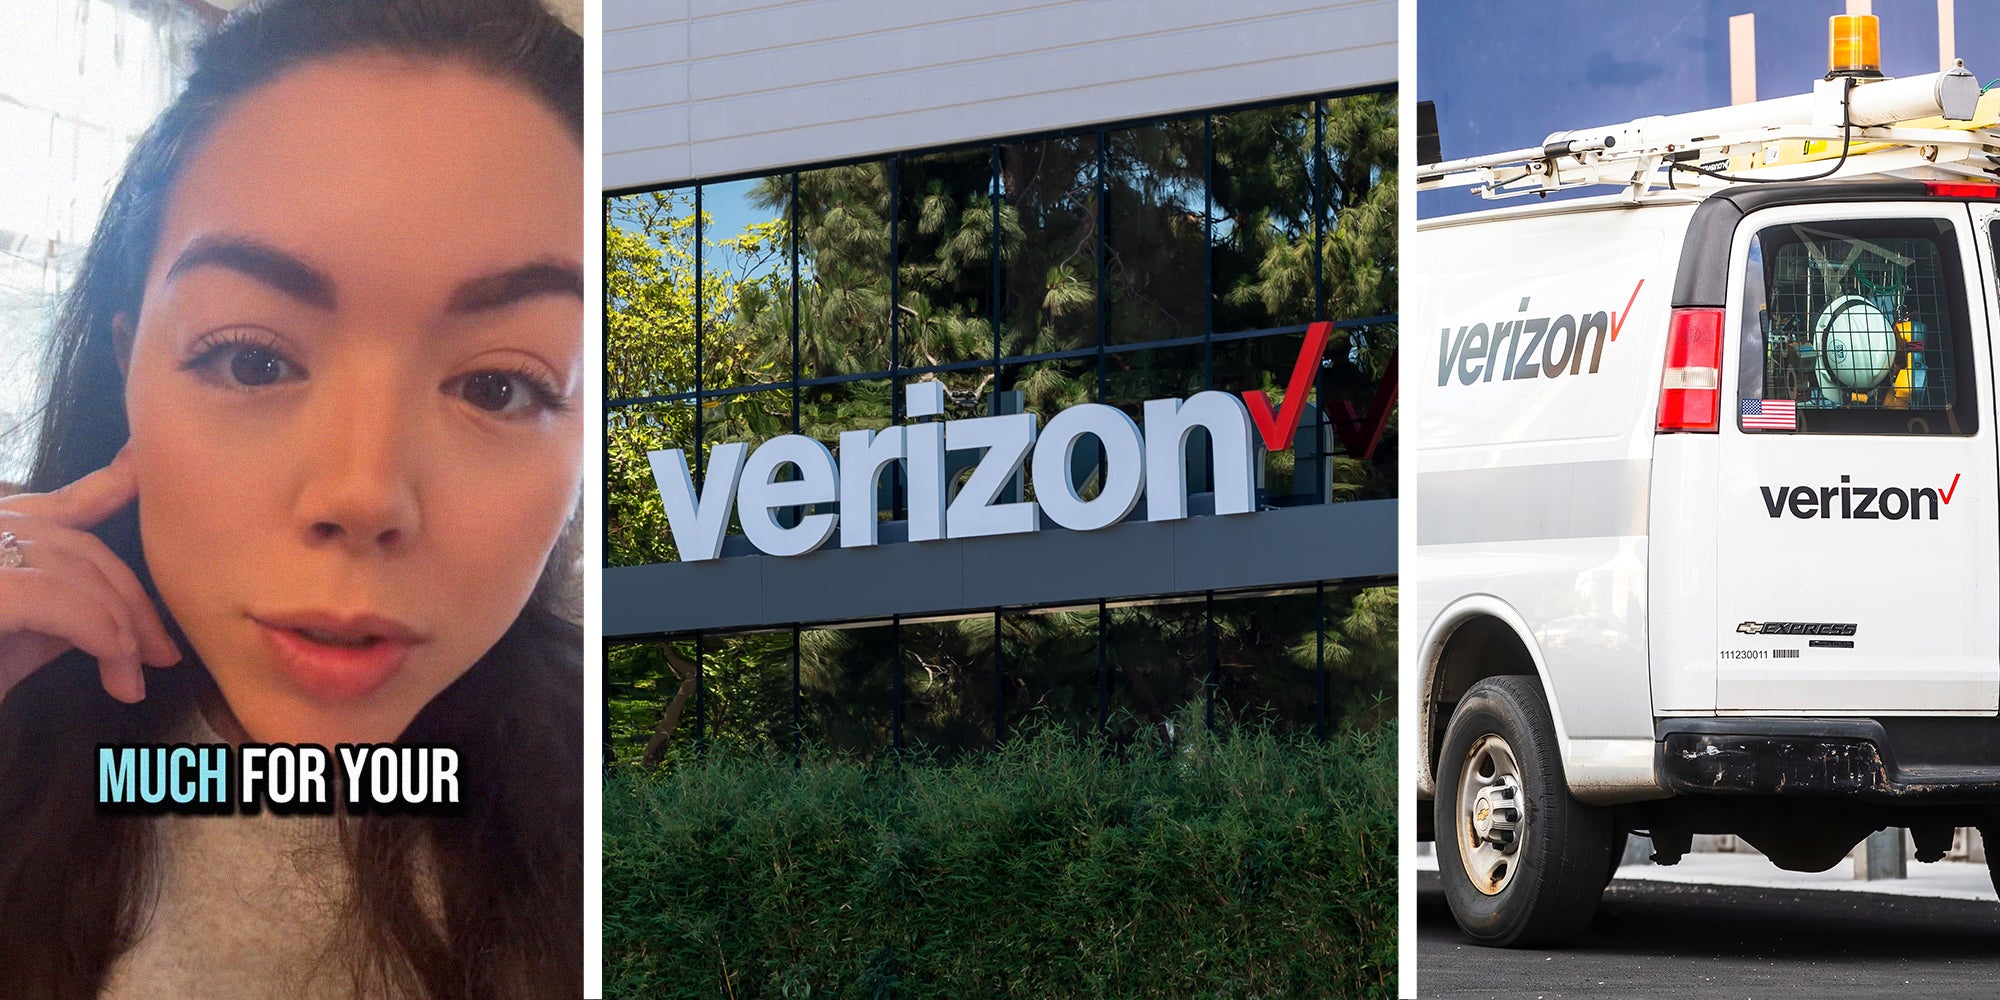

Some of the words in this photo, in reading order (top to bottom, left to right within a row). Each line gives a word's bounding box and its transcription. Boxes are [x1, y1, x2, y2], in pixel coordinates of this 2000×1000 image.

[1438, 297, 1607, 387] verizon
[647, 381, 1256, 562] verizon
[1760, 475, 1939, 520] verizon
[1761, 622, 1857, 636] EXPRESS
[1720, 650, 1768, 659] 111230011
